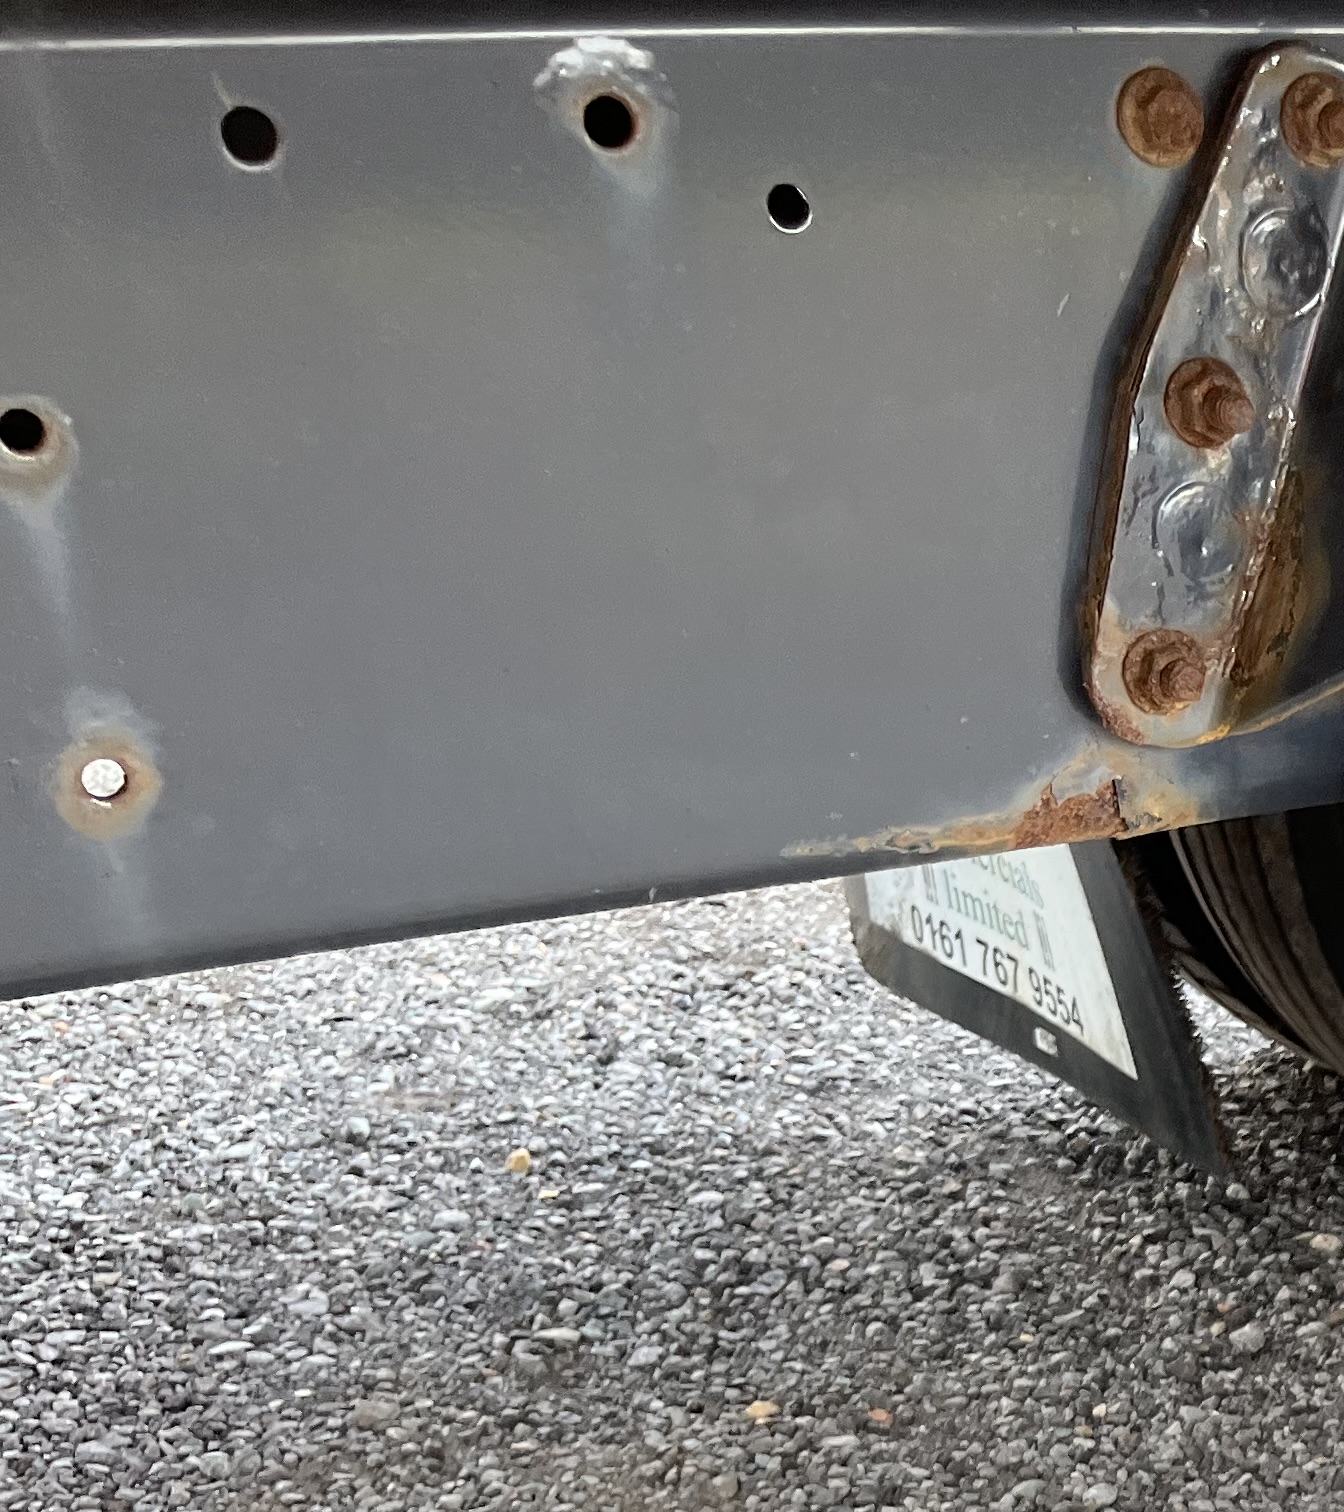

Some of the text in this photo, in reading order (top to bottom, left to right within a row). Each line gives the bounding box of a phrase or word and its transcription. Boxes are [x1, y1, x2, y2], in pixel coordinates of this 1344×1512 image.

[944, 869, 1029, 950] limited
[911, 905, 1084, 1036] 0161 767 9554
